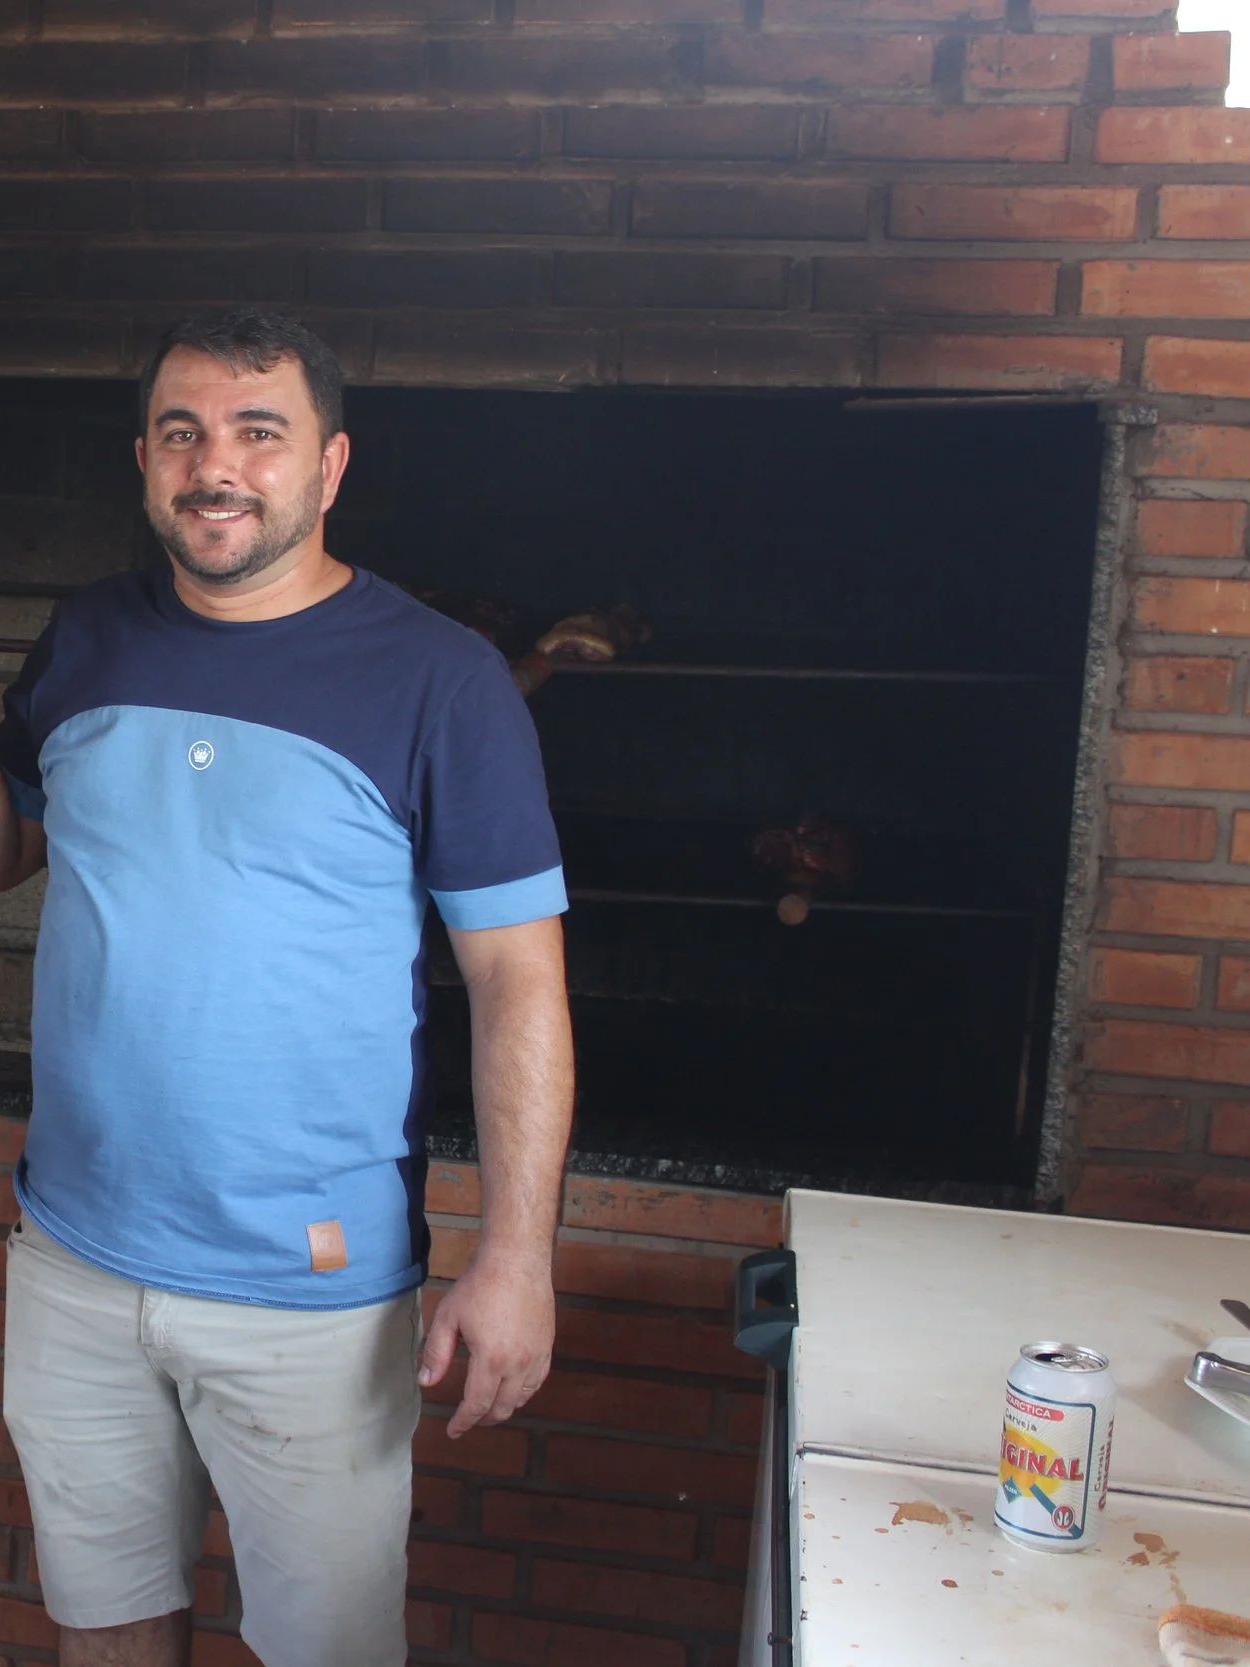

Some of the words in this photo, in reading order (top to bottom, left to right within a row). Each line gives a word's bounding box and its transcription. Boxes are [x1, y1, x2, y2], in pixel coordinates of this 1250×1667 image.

[1005, 1394, 1051, 1418] TARCTICA
[1005, 1407, 1037, 1432] Cerveja
[1000, 1434, 1084, 1480] IGINAL
